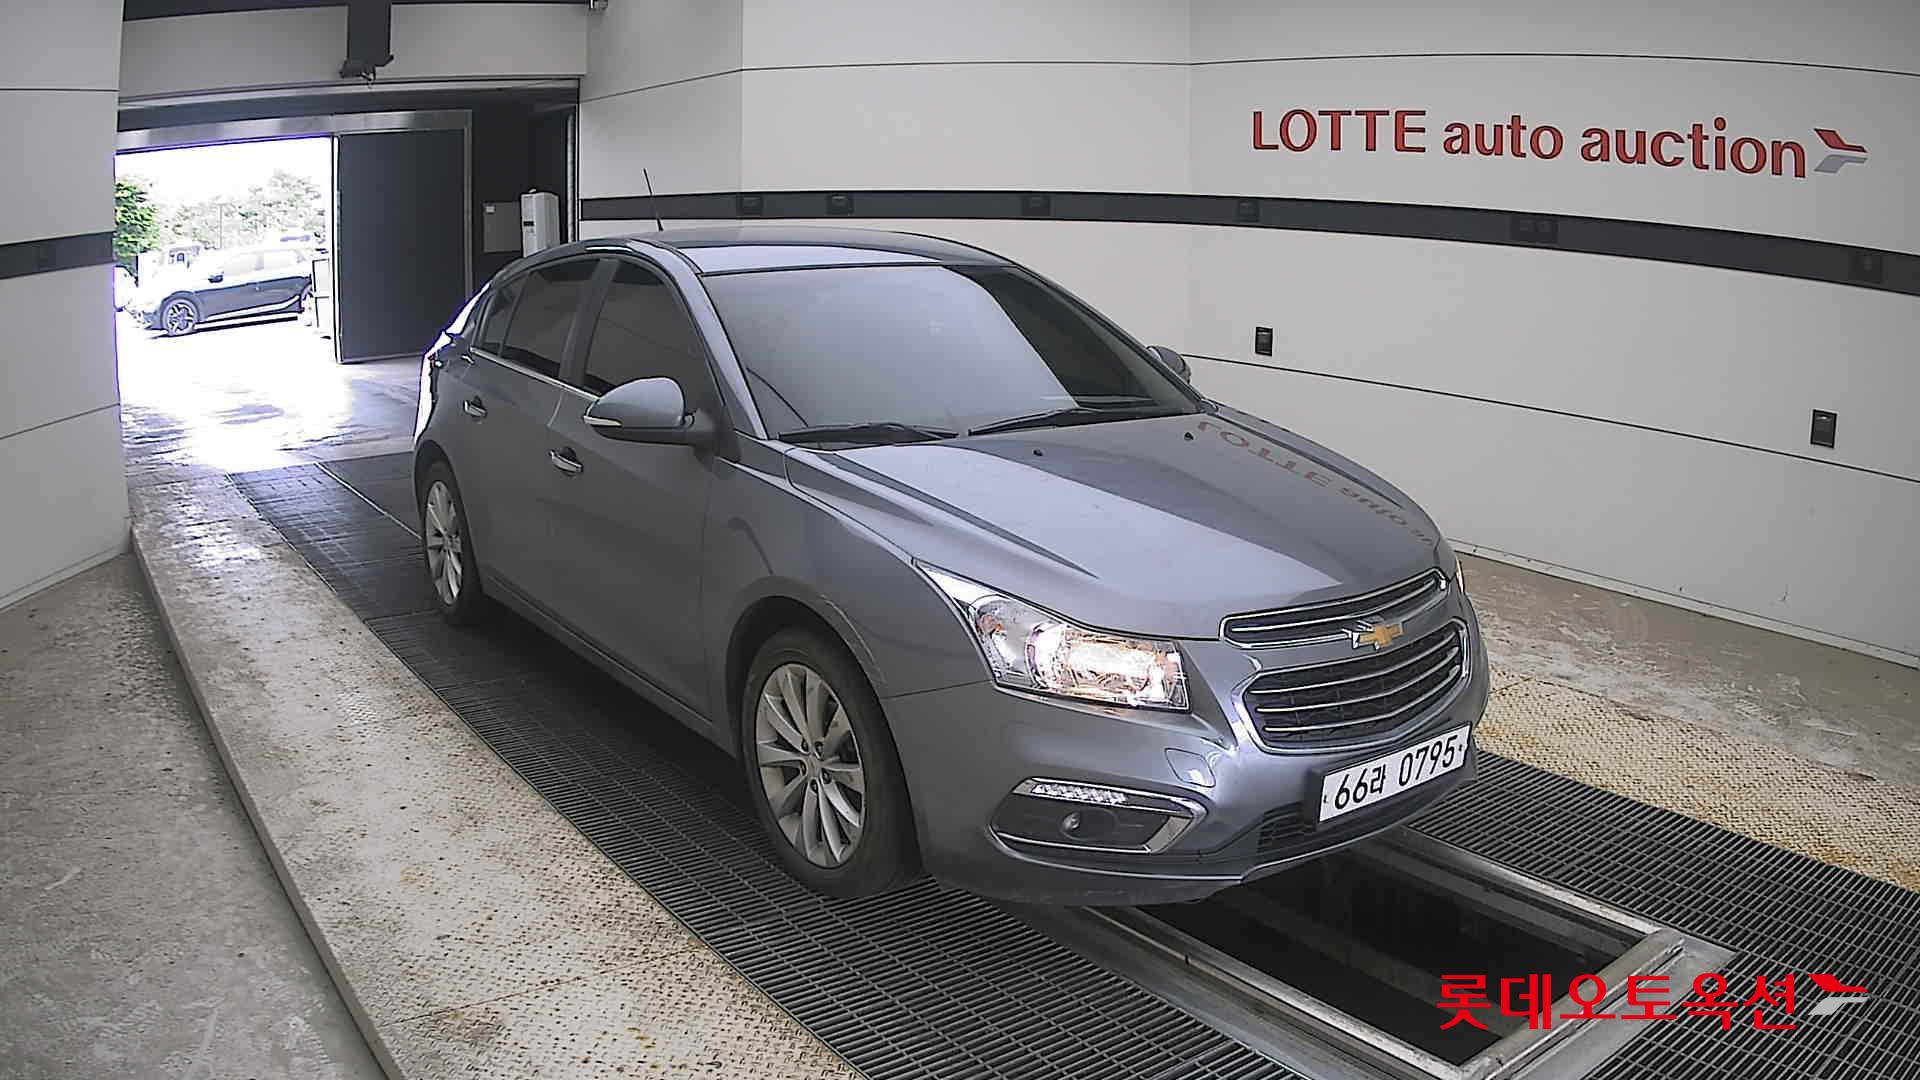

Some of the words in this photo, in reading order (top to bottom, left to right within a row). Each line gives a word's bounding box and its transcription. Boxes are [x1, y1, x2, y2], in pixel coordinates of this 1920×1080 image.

[1252, 109, 1427, 153] LOTTE
[1443, 115, 1564, 160] auto
[1580, 116, 1806, 178] auction
[1334, 763, 1386, 809] 66라
[1398, 734, 1458, 787] 0795
